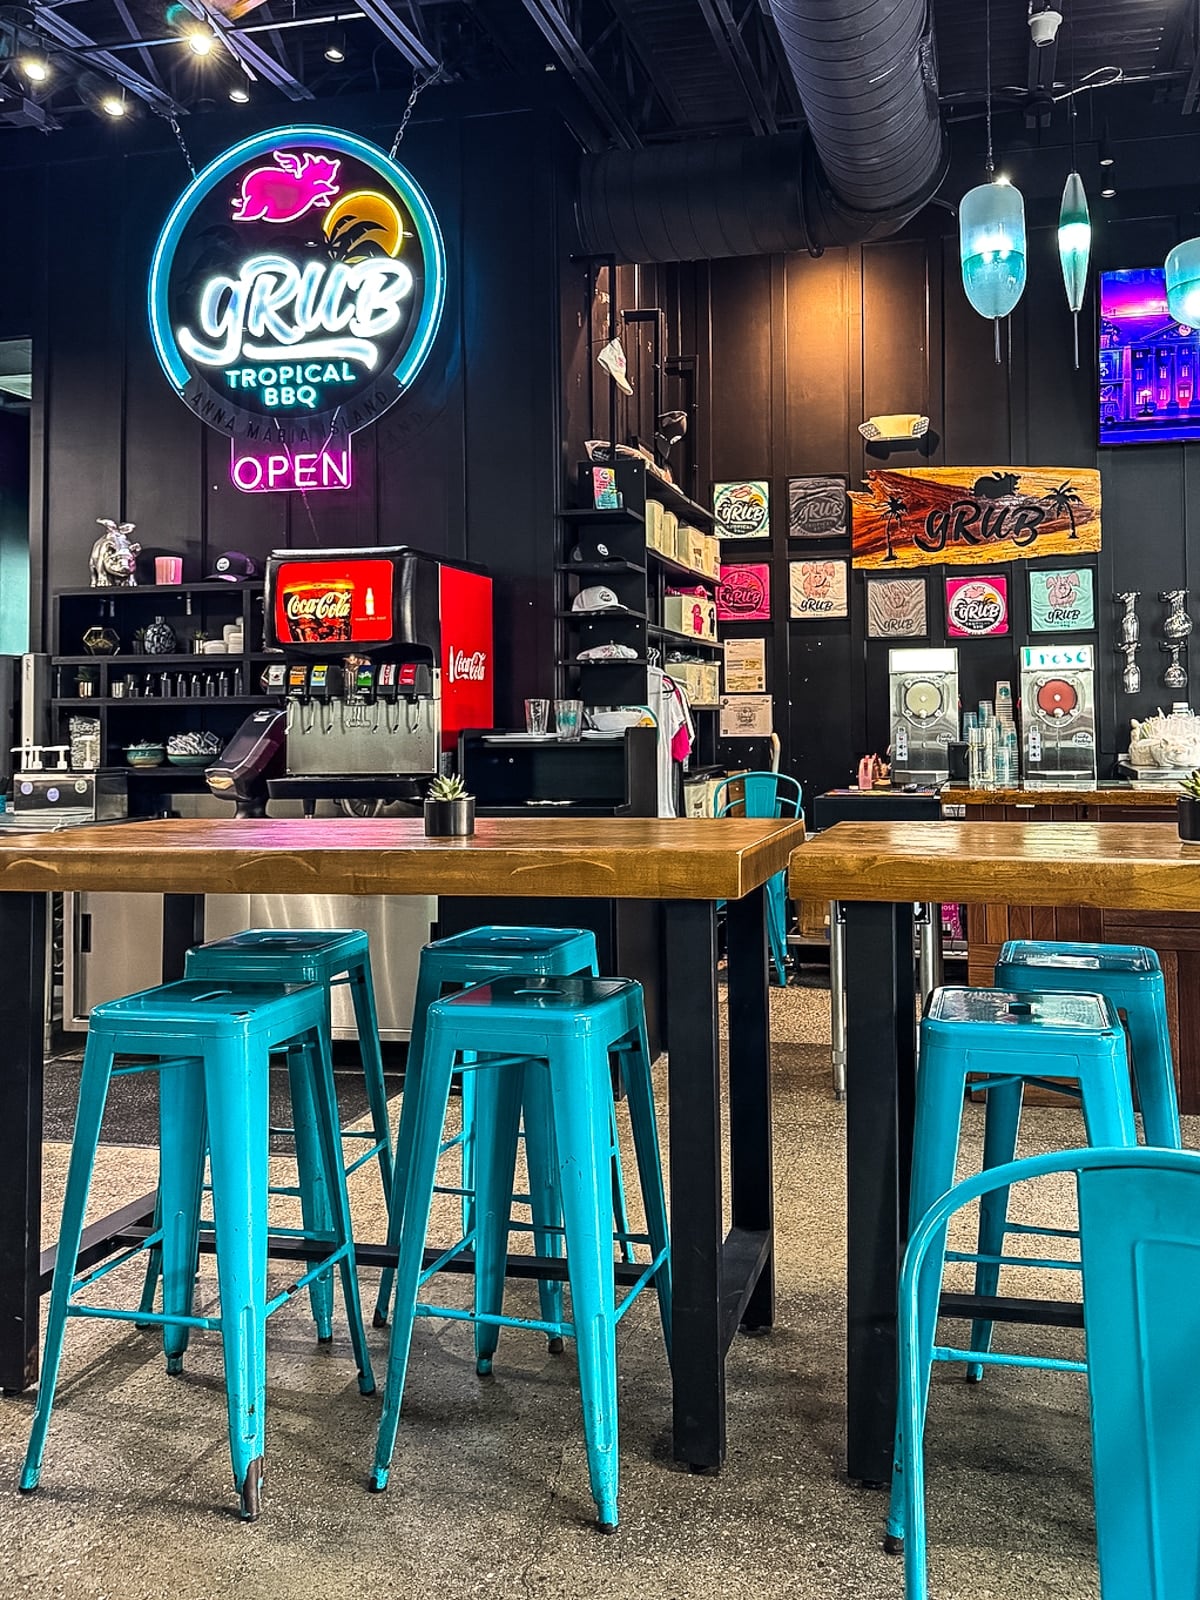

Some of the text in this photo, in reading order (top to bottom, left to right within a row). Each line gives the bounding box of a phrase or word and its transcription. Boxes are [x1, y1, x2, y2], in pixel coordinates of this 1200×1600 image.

[225, 363, 356, 388] TROPICAL
[264, 386, 317, 408] BBQ
[190, 391, 237, 432] ANNA
[246, 423, 311, 442] MARIA
[322, 390, 390, 435] ISLAND
[233, 450, 349, 490] OPEN
